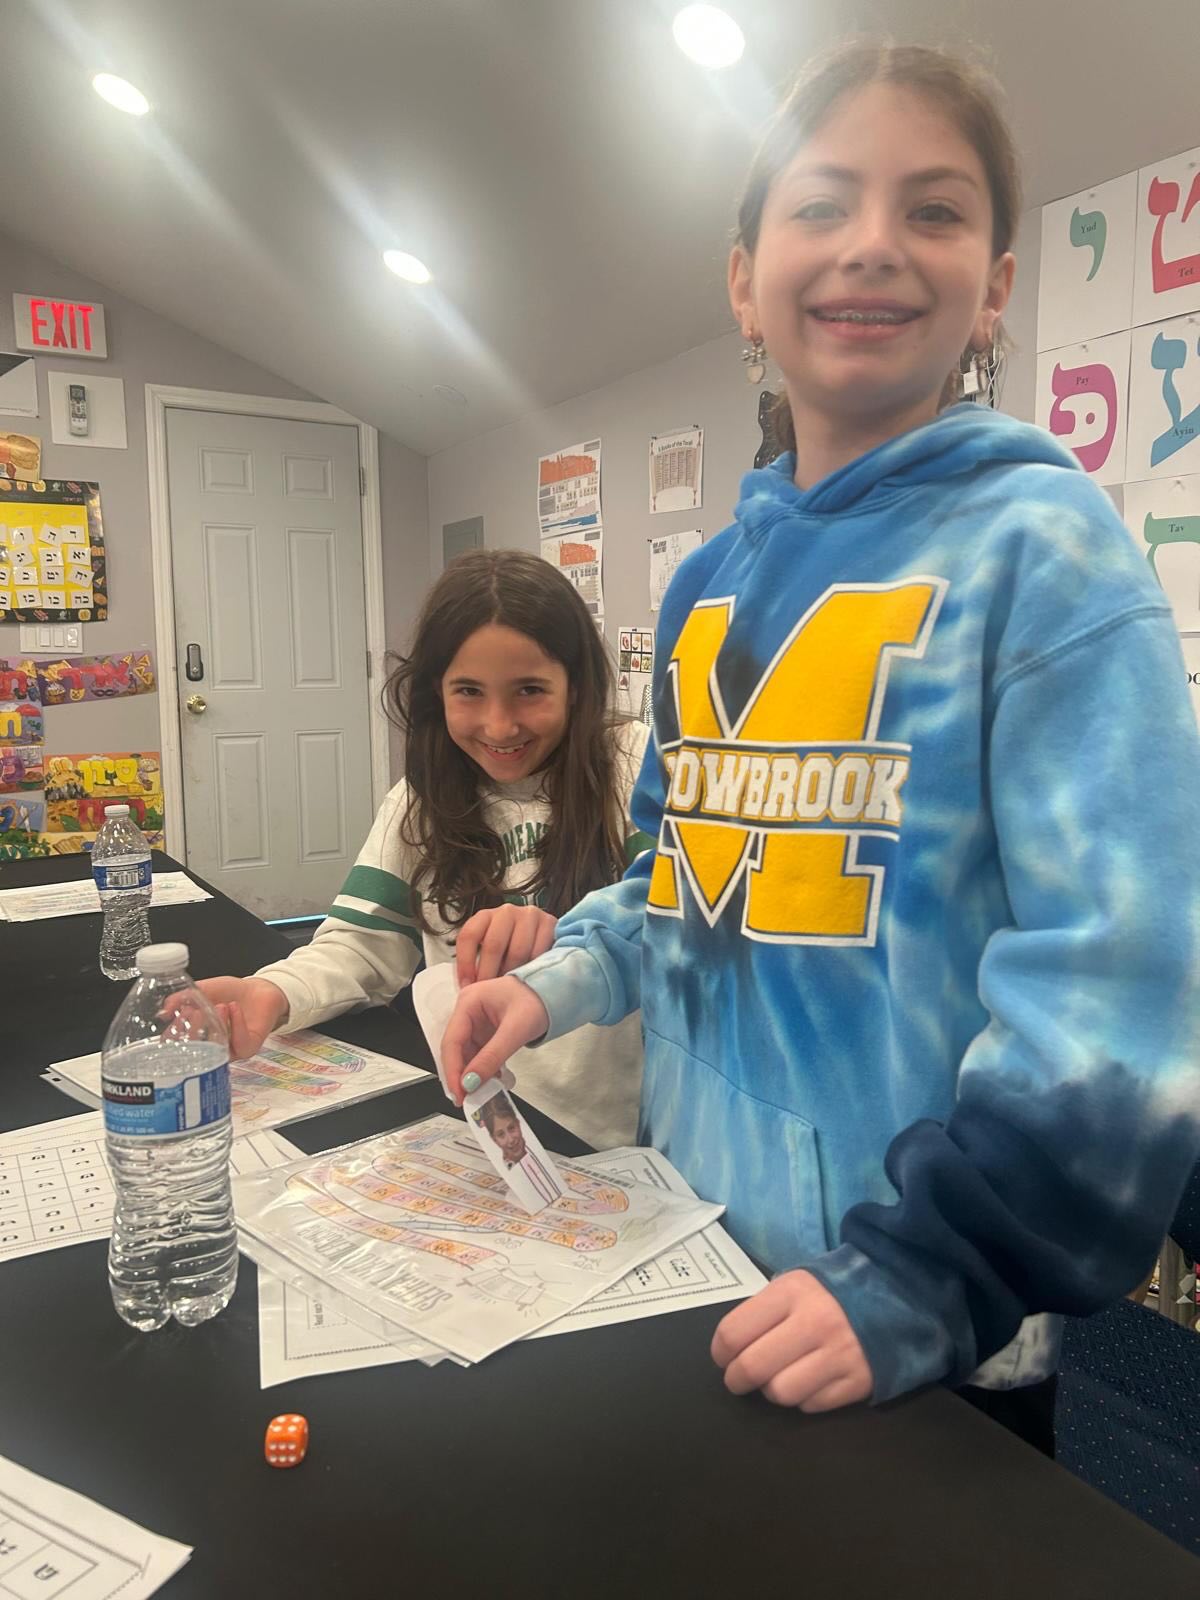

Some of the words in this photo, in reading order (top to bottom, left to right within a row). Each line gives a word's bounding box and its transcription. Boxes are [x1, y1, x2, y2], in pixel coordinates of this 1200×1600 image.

[1080, 221, 1097, 234] Yud
[1069, 206, 1107, 282] י
[1178, 266, 1194, 278] Tet
[29, 298, 94, 352] EXIT
[1076, 375, 1090, 387] Pay
[1172, 425, 1194, 438] Ayin
[1168, 523, 1185, 533] Tav
[126, 1108, 155, 1118] water
